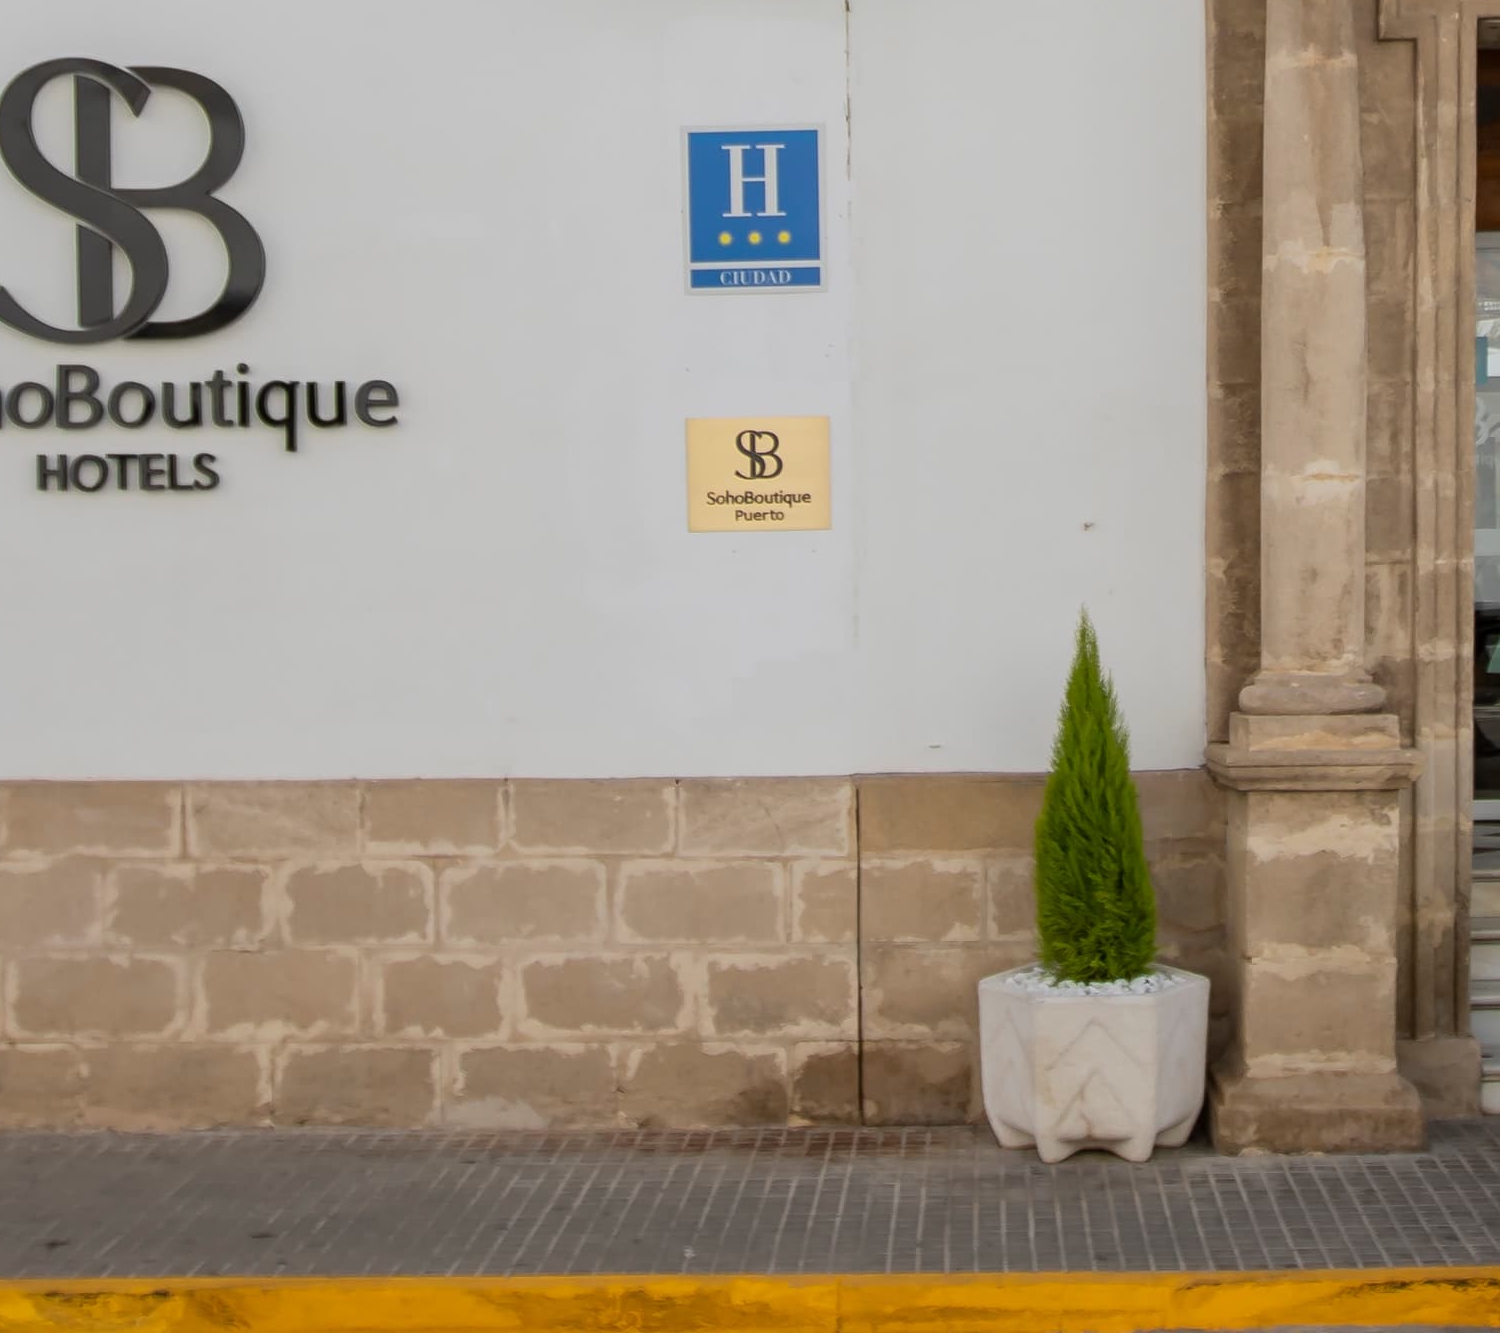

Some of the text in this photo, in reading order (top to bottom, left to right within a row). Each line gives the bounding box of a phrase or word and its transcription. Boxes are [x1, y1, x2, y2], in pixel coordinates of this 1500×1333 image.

[721, 144, 787, 217] H
[719, 269, 792, 286] CIUDAD
[35, 452, 221, 493] HOTELS
[706, 490, 812, 508] SohoBoutique
[735, 510, 785, 521] Puerto
